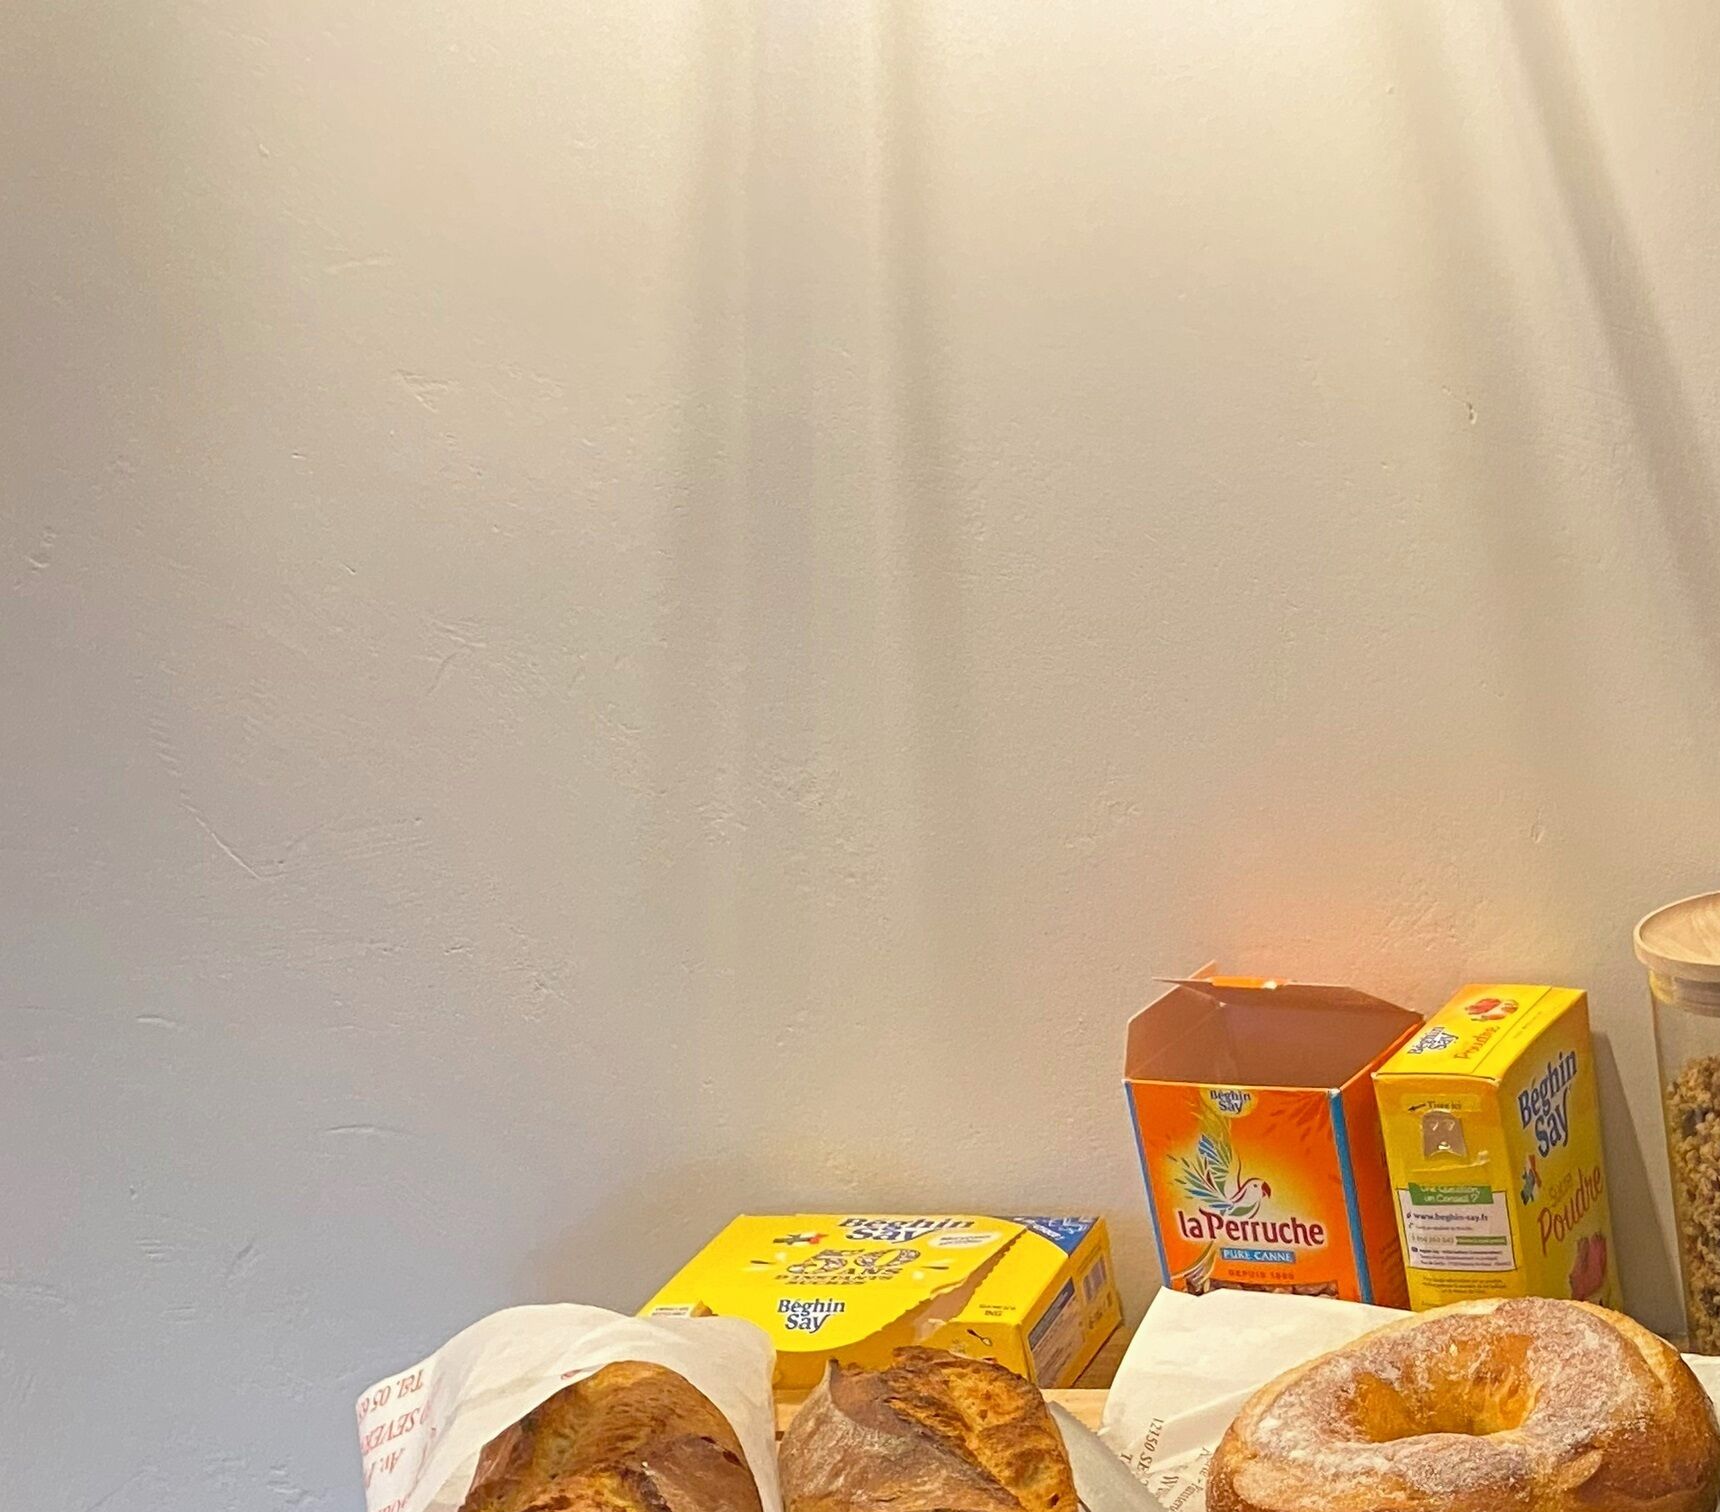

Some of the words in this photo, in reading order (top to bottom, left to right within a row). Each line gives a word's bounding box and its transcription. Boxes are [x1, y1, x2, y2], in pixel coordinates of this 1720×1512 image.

[1209, 1088, 1251, 1104] Béghin
[1518, 1050, 1578, 1129] Béghin
[1219, 1100, 1245, 1114] Say
[1535, 1089, 1570, 1158] Say
[1537, 1165, 1603, 1256] Poudre
[838, 1218, 975, 1231] Béghin
[1199, 1208, 1324, 1247] Perruche
[846, 1228, 938, 1245] Say
[1223, 1249, 1250, 1260] PURE
[1253, 1251, 1293, 1263] CANNE
[777, 1298, 846, 1317] Béghin
[785, 1313, 831, 1335] Say
[1144, 1418, 1164, 1452] 12150
